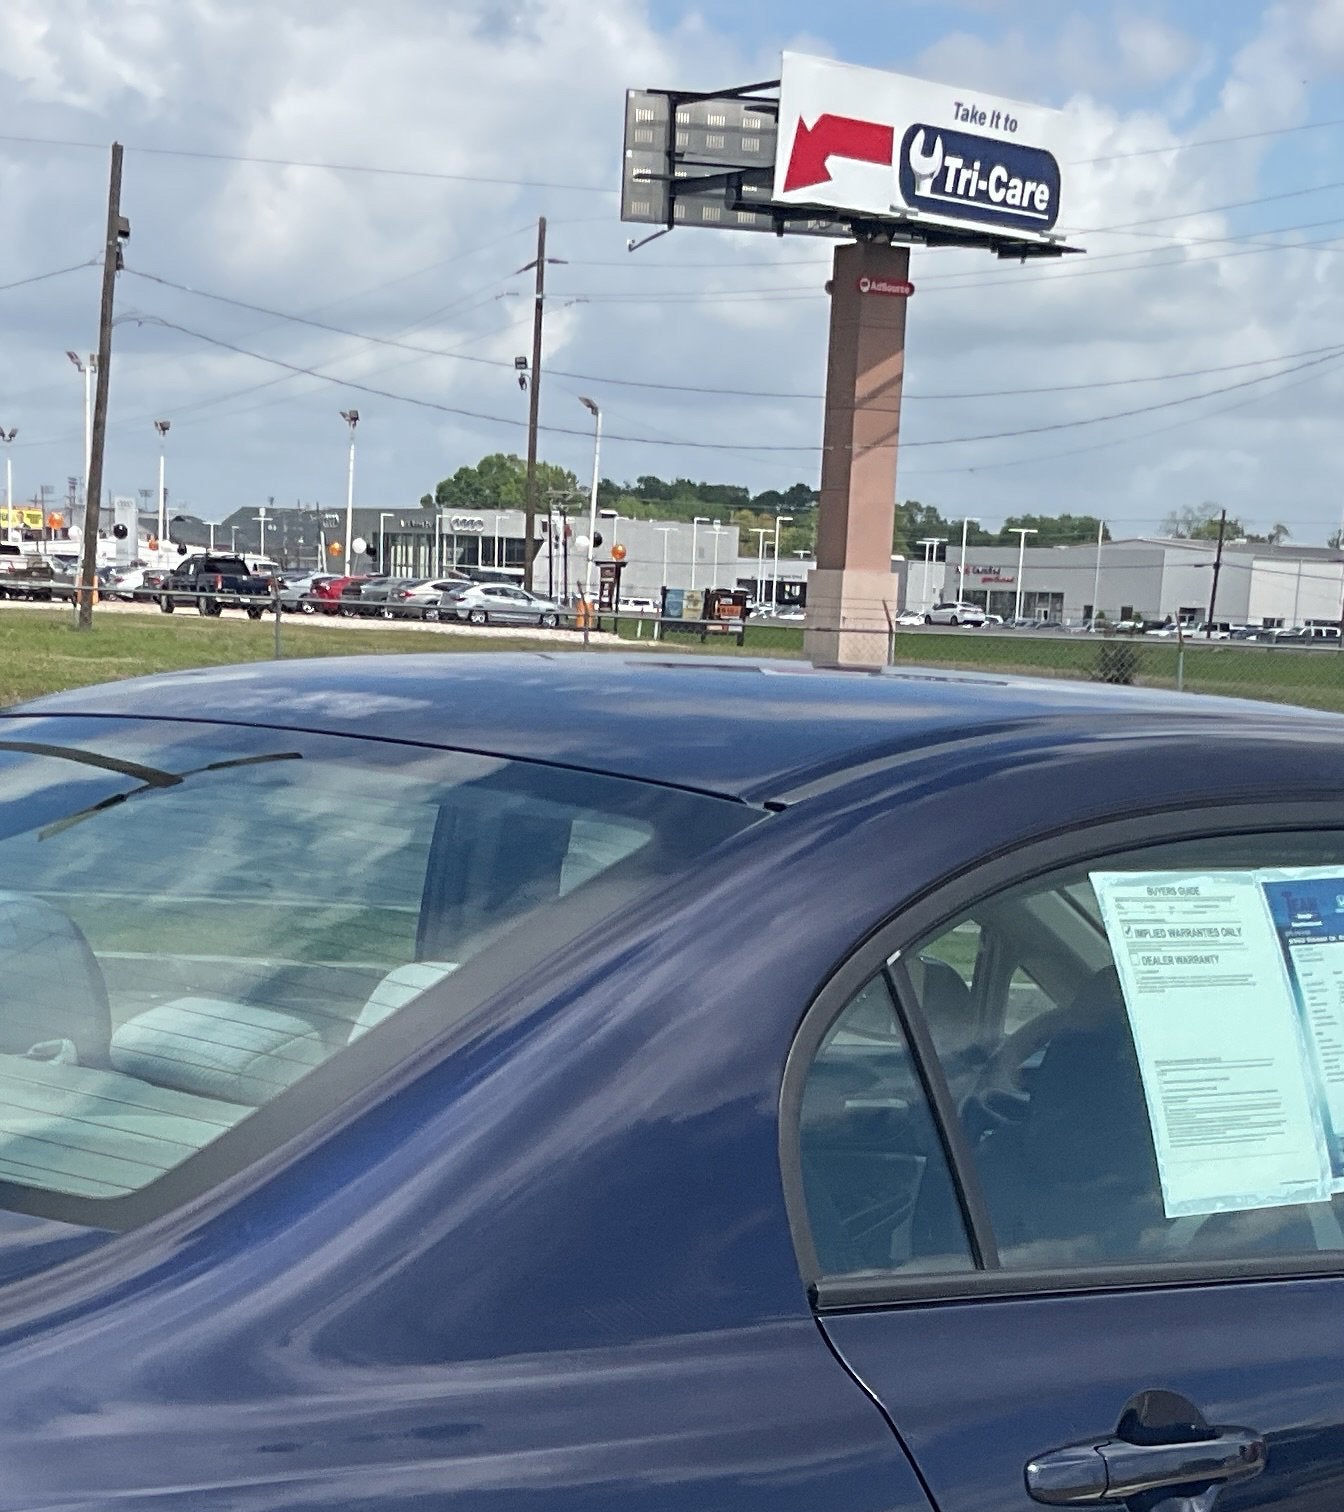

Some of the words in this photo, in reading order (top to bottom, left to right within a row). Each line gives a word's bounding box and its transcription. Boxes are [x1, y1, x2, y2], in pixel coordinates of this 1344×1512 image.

[954, 101, 987, 126] Take
[990, 110, 1001, 129] It
[1003, 113, 1018, 133] to
[944, 155, 1050, 211] Tri-Care
[1146, 886, 1177, 897] BUYERS
[1178, 886, 1200, 896] GUIDE
[1134, 928, 1166, 939] IMPLIED
[1168, 927, 1220, 938] WARRANTIES
[1221, 927, 1242, 938] ONLY
[1142, 955, 1174, 966] DEALER
[1175, 954, 1219, 965] WARRANTY
